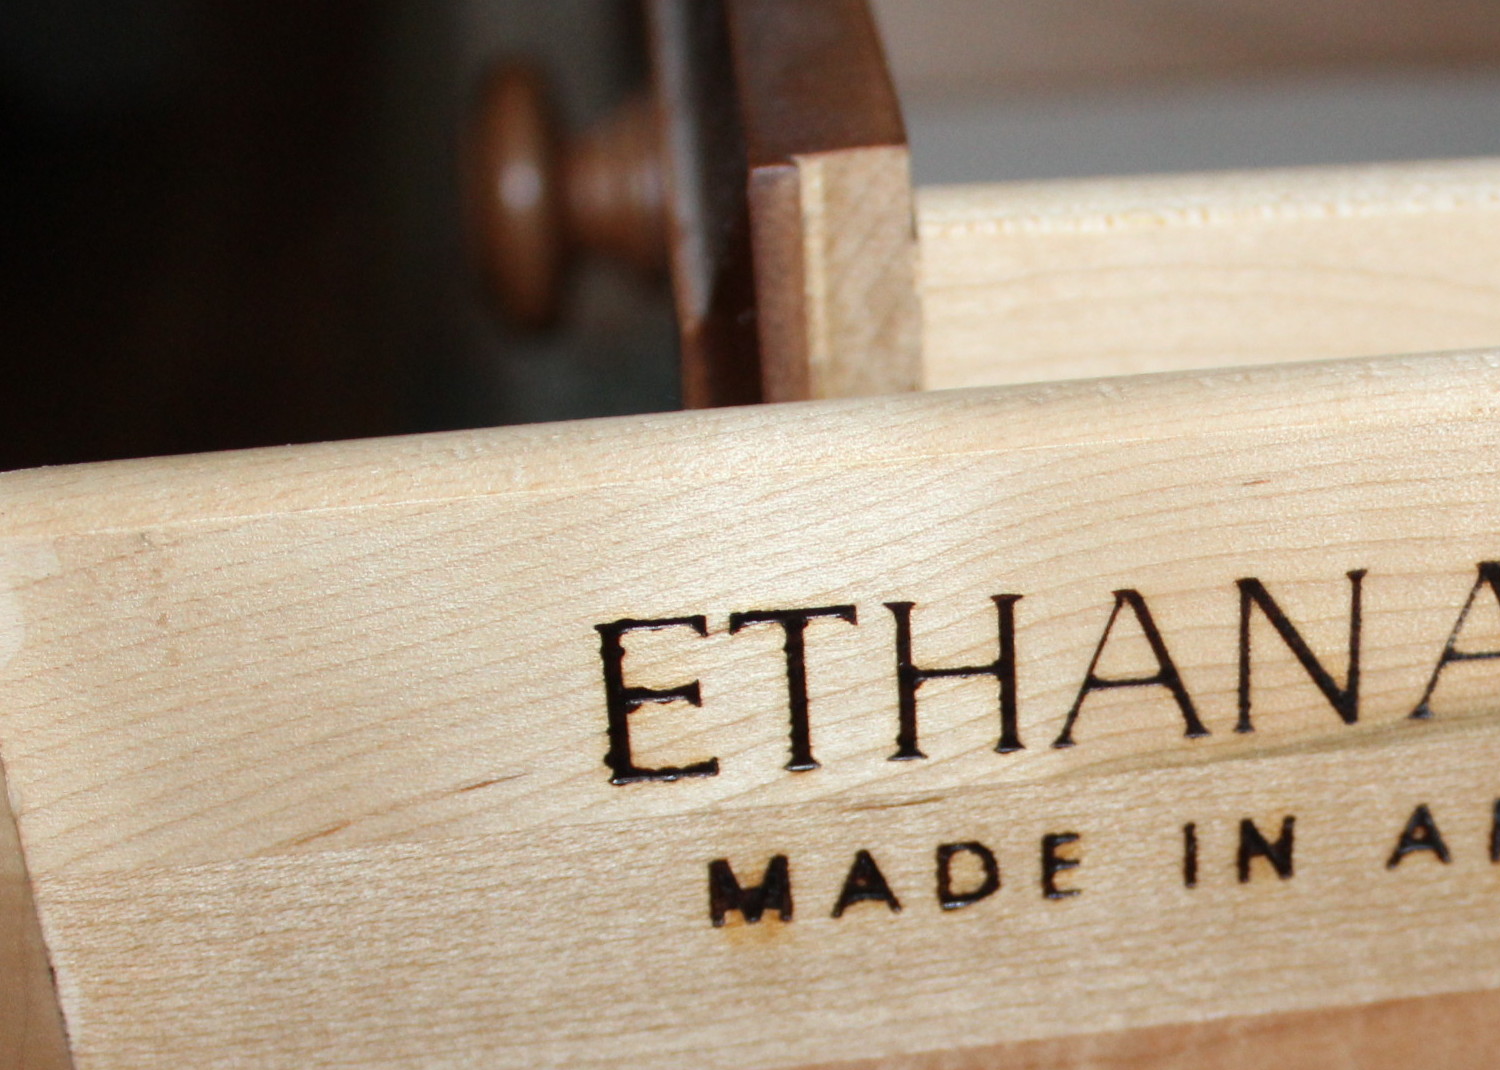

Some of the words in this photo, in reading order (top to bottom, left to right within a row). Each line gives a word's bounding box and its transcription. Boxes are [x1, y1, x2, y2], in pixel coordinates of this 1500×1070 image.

[593, 568, 1368, 788] ETHAN
[706, 830, 1081, 930] MADE
[1181, 814, 1297, 890] IN
